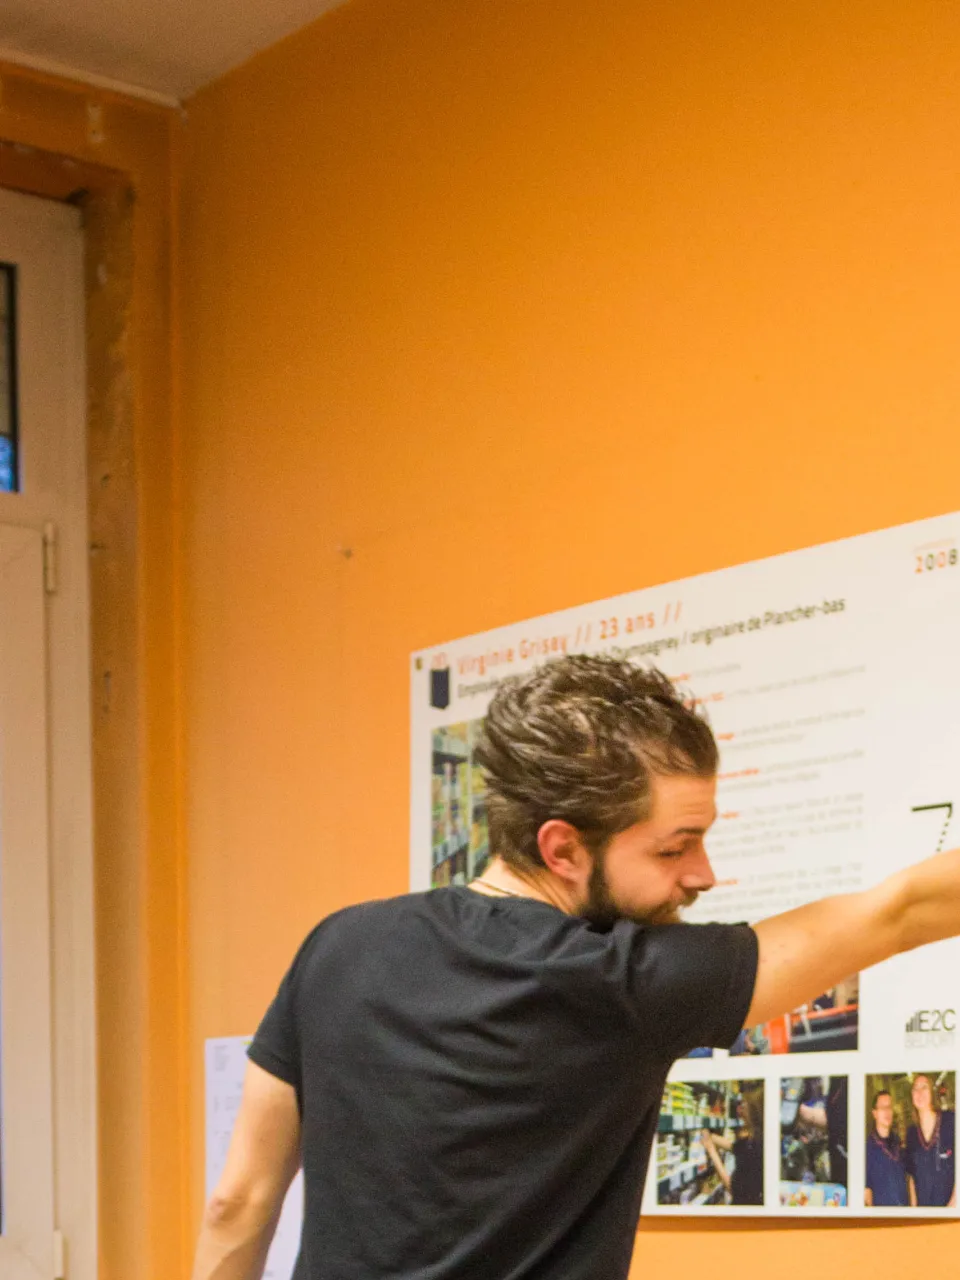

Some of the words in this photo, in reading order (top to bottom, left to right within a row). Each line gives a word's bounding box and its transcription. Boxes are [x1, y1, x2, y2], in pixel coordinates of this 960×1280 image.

[457, 647, 514, 675] Virginie
[519, 636, 567, 660] Grisey
[599, 617, 619, 640] 23
[625, 612, 656, 634] ans
[689, 619, 745, 645] originaire
[747, 616, 761, 630] de
[764, 598, 846, 623] Plancher-bas
[919, 1009, 956, 1033] E2C
